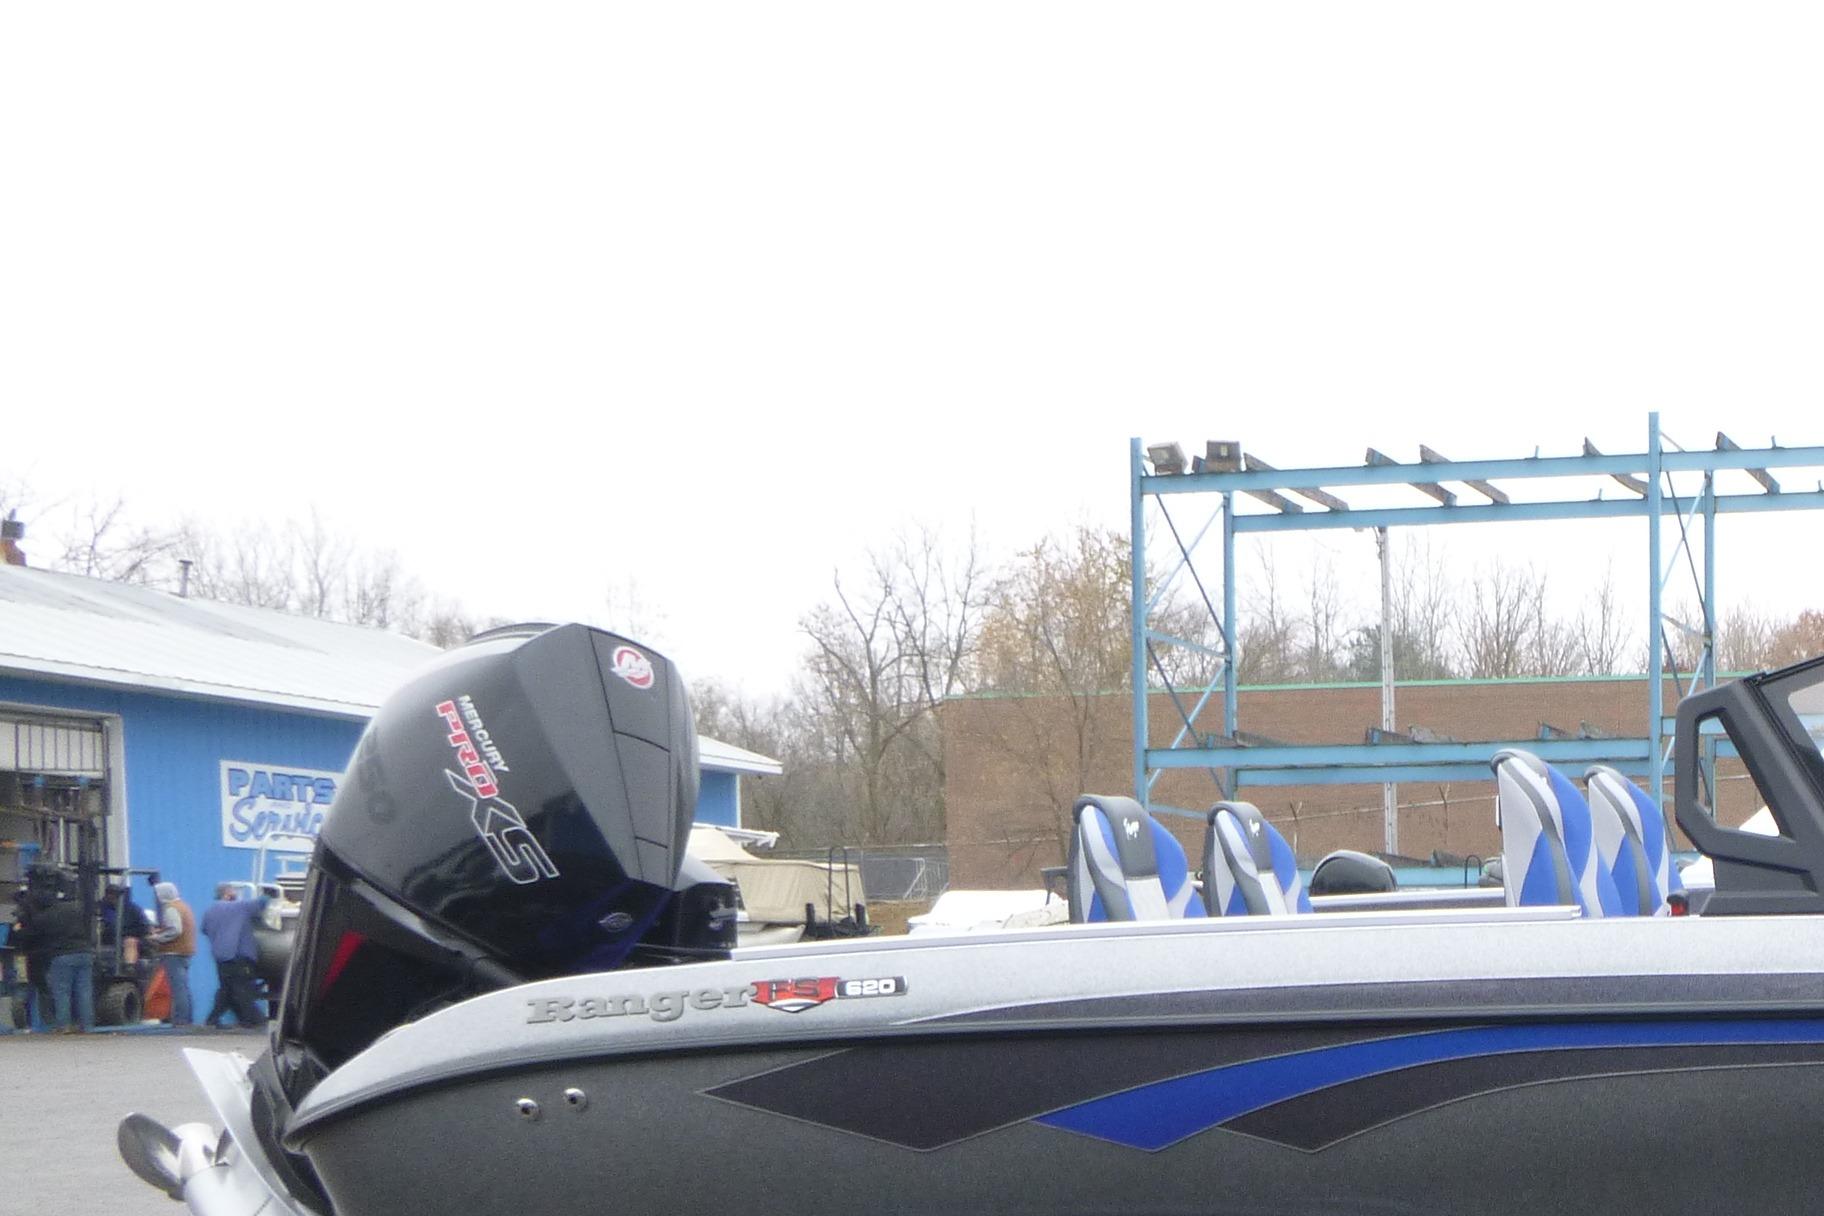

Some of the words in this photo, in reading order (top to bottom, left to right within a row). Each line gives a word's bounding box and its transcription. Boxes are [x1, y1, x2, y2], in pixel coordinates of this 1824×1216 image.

[435, 699, 499, 799] PRO
[458, 694, 510, 772] MERCURY
[228, 767, 337, 806] PARTS
[229, 796, 324, 842] Servic
[444, 768, 560, 884] XS
[526, 984, 757, 1023] Ranger
[845, 979, 896, 996] 620
